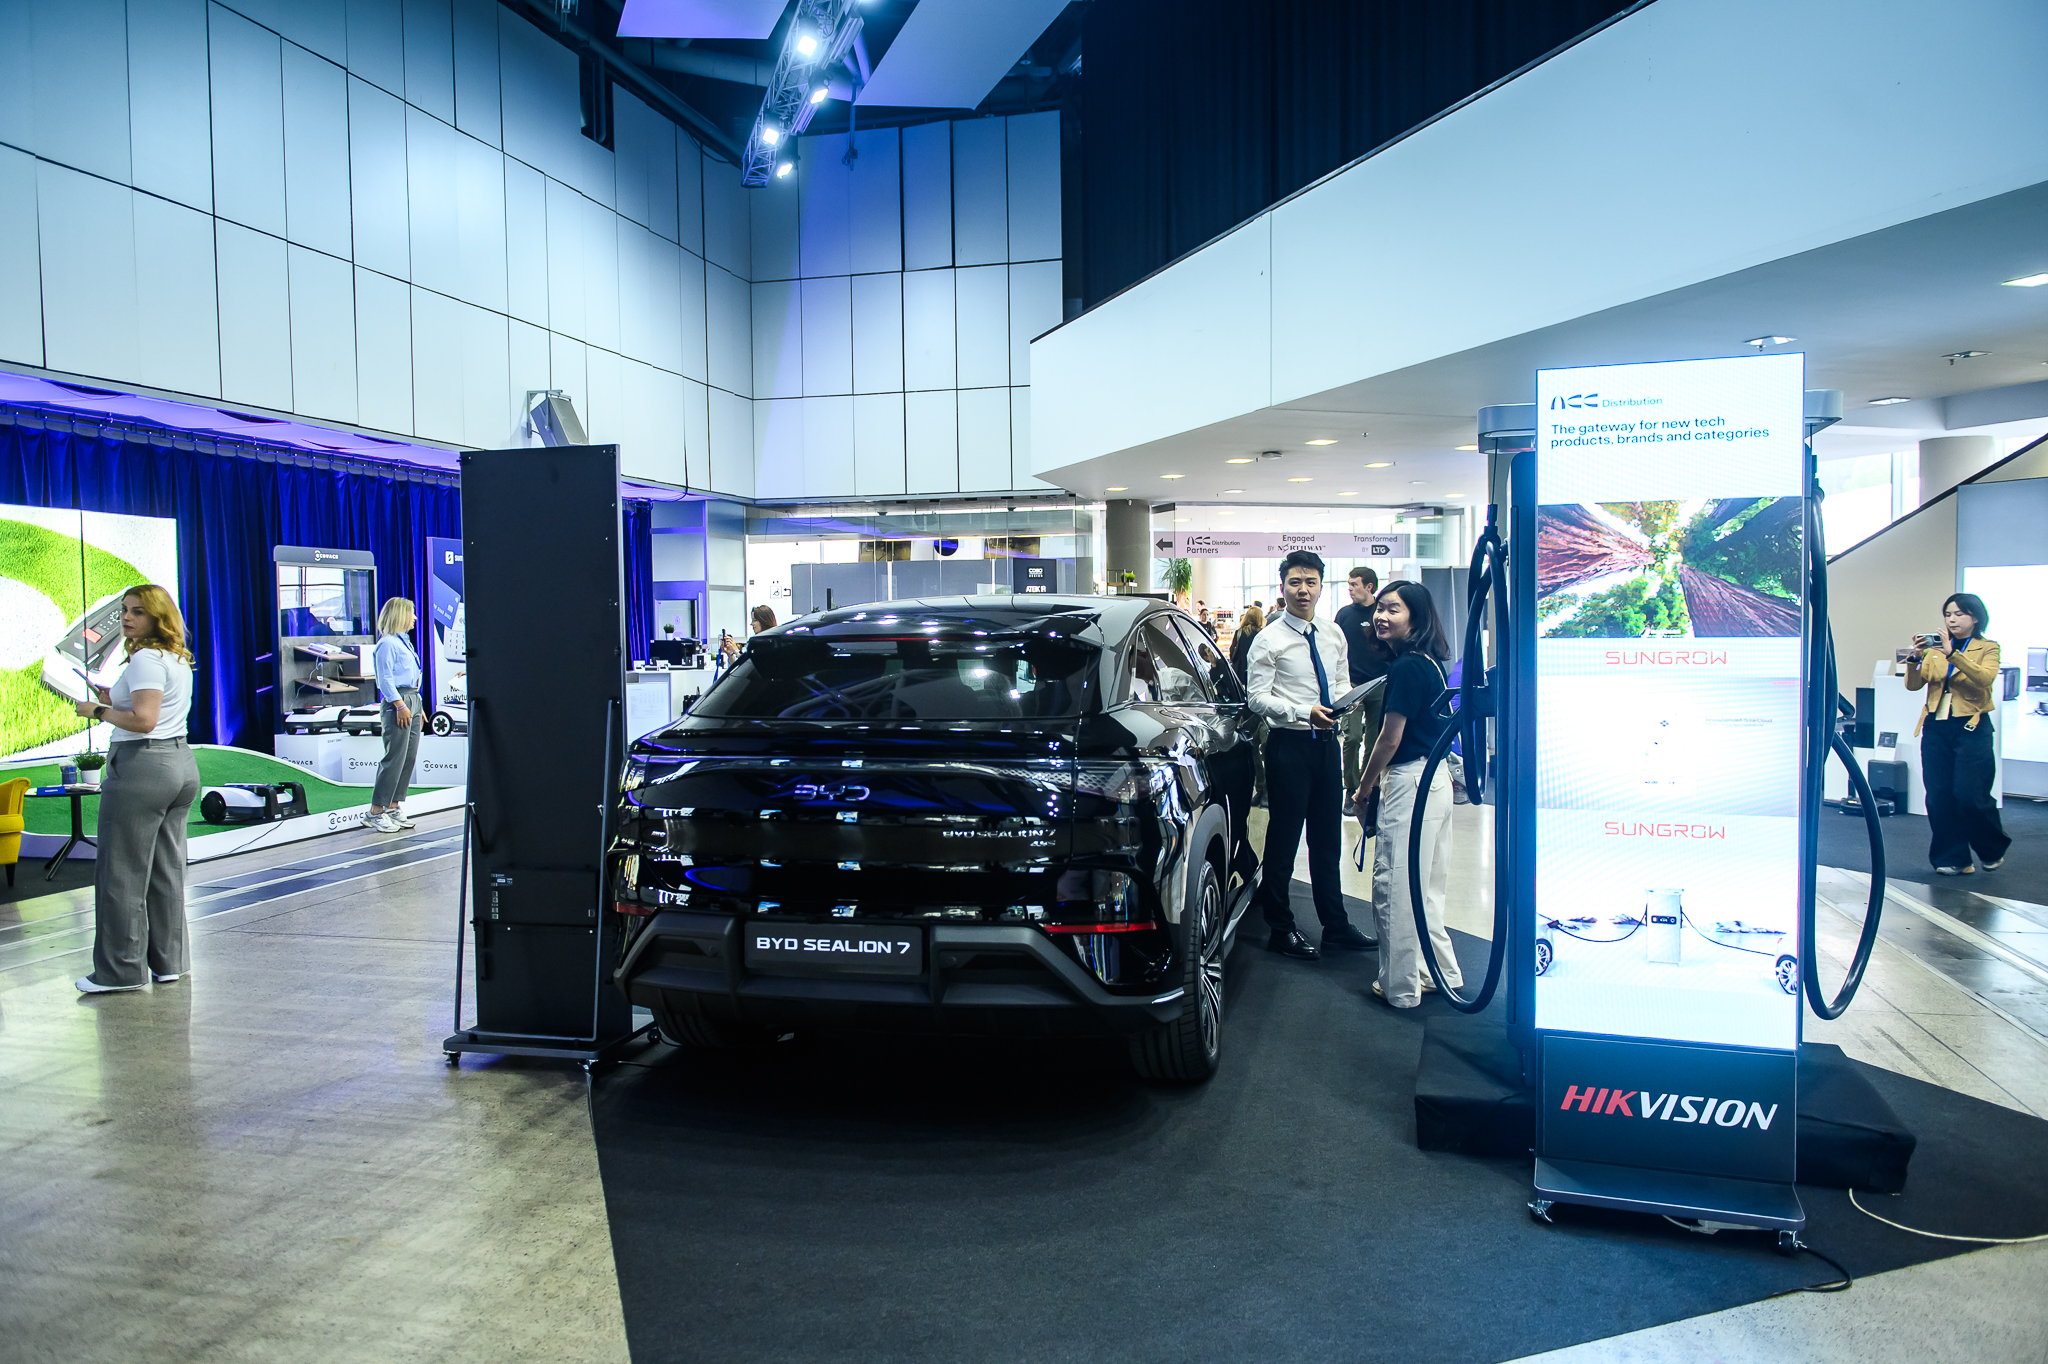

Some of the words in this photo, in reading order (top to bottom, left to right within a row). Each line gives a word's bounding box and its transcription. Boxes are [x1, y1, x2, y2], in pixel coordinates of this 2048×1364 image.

[1602, 397, 1663, 408] Distribution
[1551, 424, 1576, 434] The
[1578, 423, 1636, 436] gateway
[1640, 420, 1659, 430] for
[1661, 420, 1691, 429] new
[1695, 416, 1725, 427] tech
[1617, 433, 1663, 444] brands
[1666, 431, 1691, 442] and
[1695, 427, 1770, 442] categories
[1282, 534, 1315, 543] Engaged
[1605, 651, 1727, 665] SUNGROW
[423, 760, 458, 772] ECOVACS
[793, 784, 870, 801] BYD
[1045, 828, 1057, 837] 7
[1604, 821, 1726, 839] SUNGROW
[756, 936, 798, 950] BYD
[803, 938, 892, 954] SEALION
[896, 941, 911, 955] 7
[1560, 1085, 1778, 1130] HIKVISION
